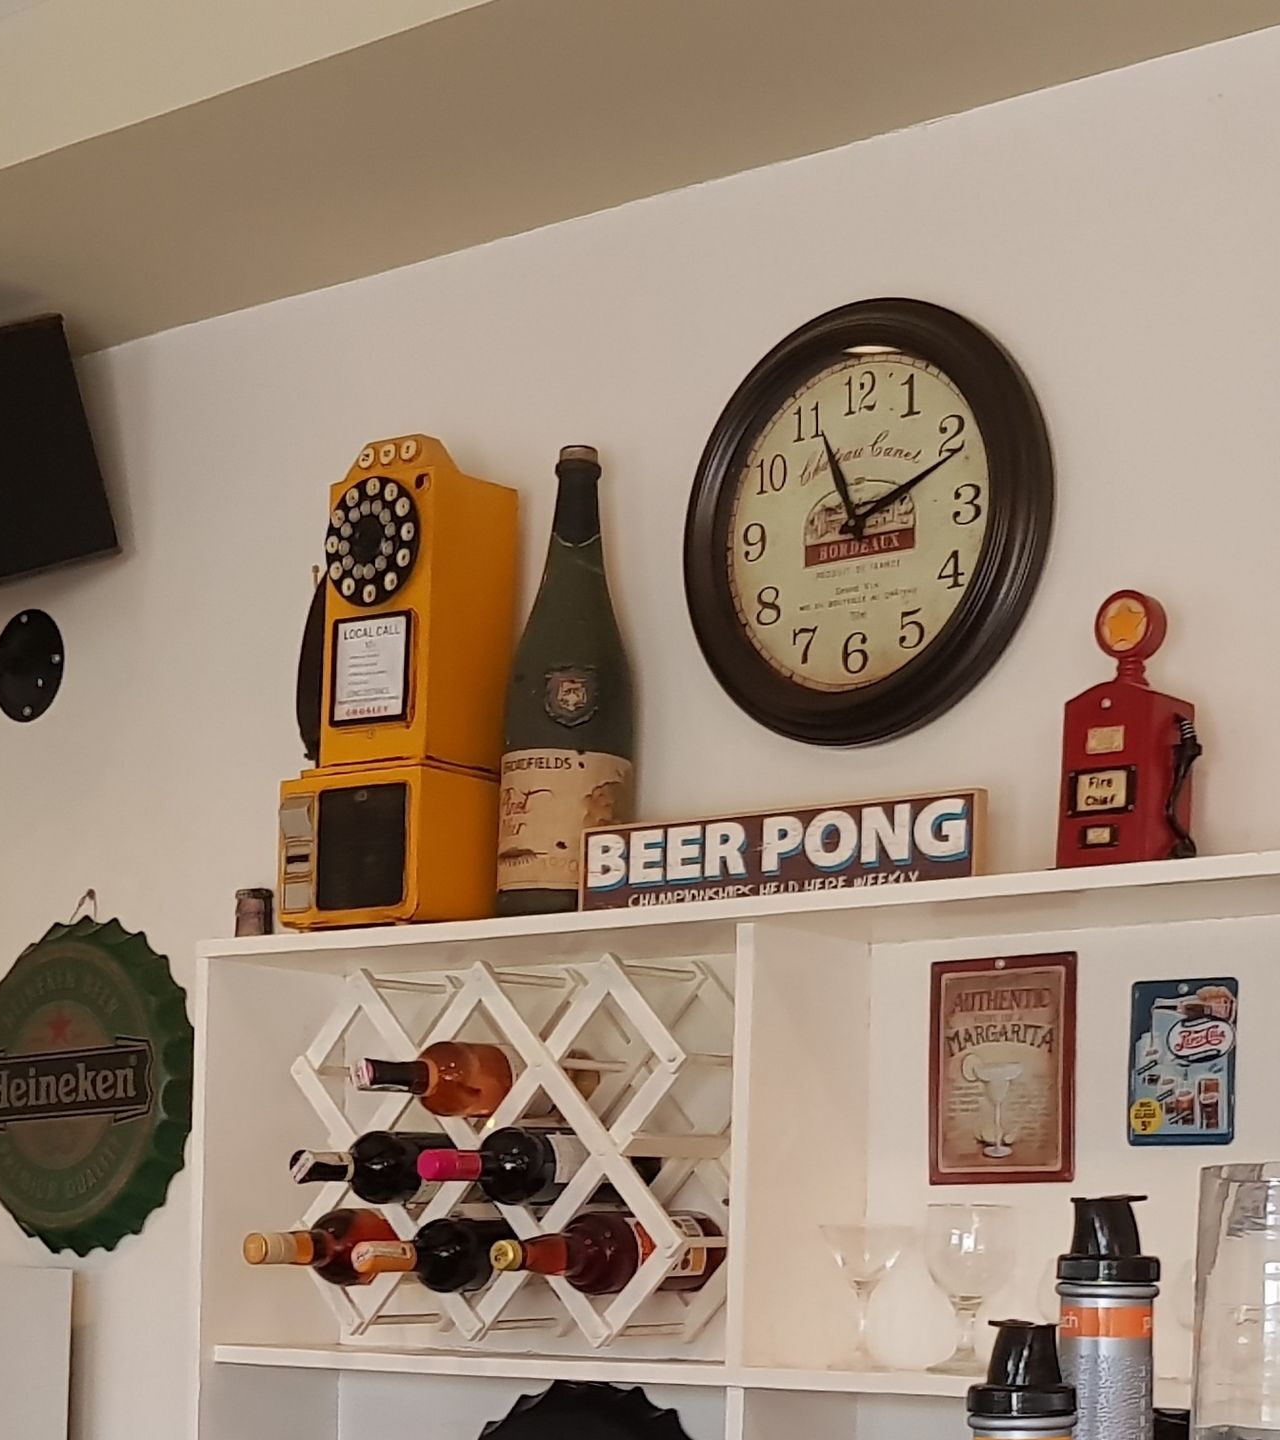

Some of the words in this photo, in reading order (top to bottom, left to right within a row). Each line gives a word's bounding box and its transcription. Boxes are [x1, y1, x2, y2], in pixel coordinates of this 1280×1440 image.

[843, 371, 876, 417] 12
[899, 373, 921, 418] 1
[792, 402, 823, 443] 11
[937, 414, 965, 457] 2
[755, 453, 787, 495] 10
[952, 484, 982, 525] 3
[742, 522, 767, 562] 9
[819, 532, 900, 561] BORDEAUX
[936, 549, 966, 590] 4
[755, 586, 782, 626] 8
[343, 627, 374, 641] LOCAL
[376, 624, 401, 637] CALL
[792, 625, 818, 665] 7
[898, 607, 925, 650] 5
[840, 632, 869, 675] 6
[1085, 793, 1118, 807] Chief
[1088, 776, 1113, 789] Fire
[586, 822, 747, 890] BEER
[761, 798, 968, 874] PONG
[627, 883, 757, 909] CHAMPIONSHIPS
[951, 987, 1052, 1014] AUTHENTIC
[944, 1023, 1055, 1057] MARGARITA
